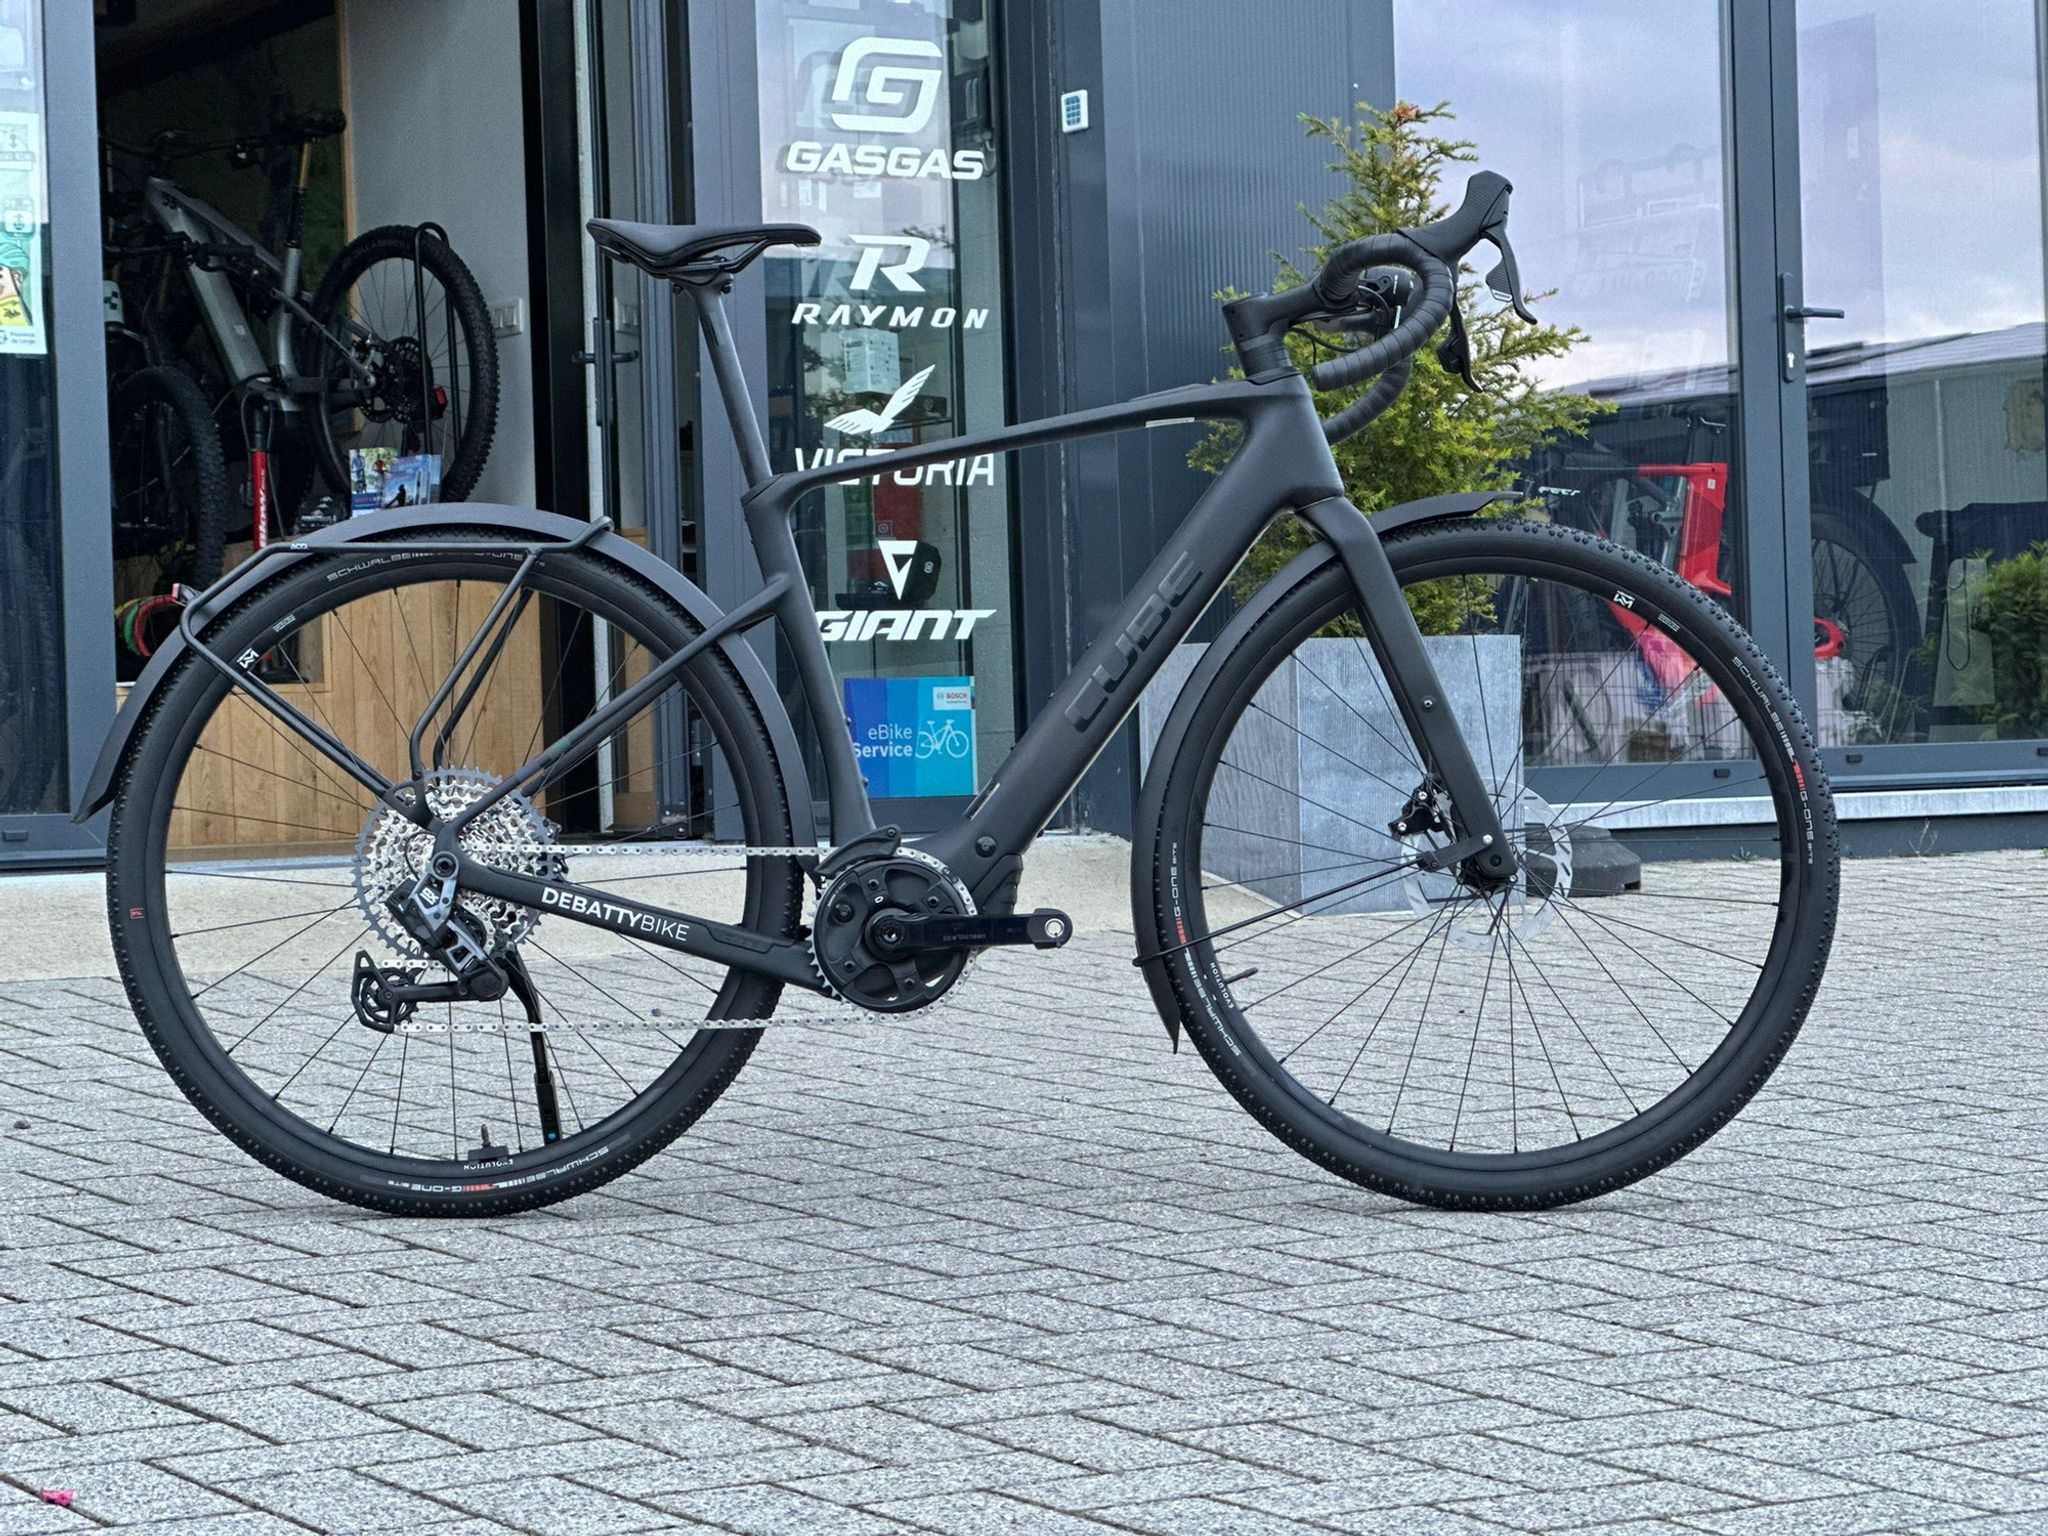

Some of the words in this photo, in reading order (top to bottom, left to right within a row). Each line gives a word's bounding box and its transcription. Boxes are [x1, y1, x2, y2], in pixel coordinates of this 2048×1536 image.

[785, 140, 985, 180] GASGAS
[791, 303, 989, 329] RAYMON
[795, 448, 994, 486] VICTORIA
[815, 609, 997, 641] GIANT
[1064, 550, 1204, 733] CUBE
[1732, 656, 1785, 732] SCHWALBE
[853, 742, 913, 758] Service
[868, 724, 913, 740] eBike
[541, 887, 691, 942] DEBATTYBIKE
[1210, 962, 1235, 1009] EVOLUTION
[1193, 978, 1242, 1057] SCHWALBE
[463, 1158, 515, 1172] EVOLUTION
[525, 1146, 610, 1186] SCHWALBE
[411, 1182, 463, 1194] G-ONE
